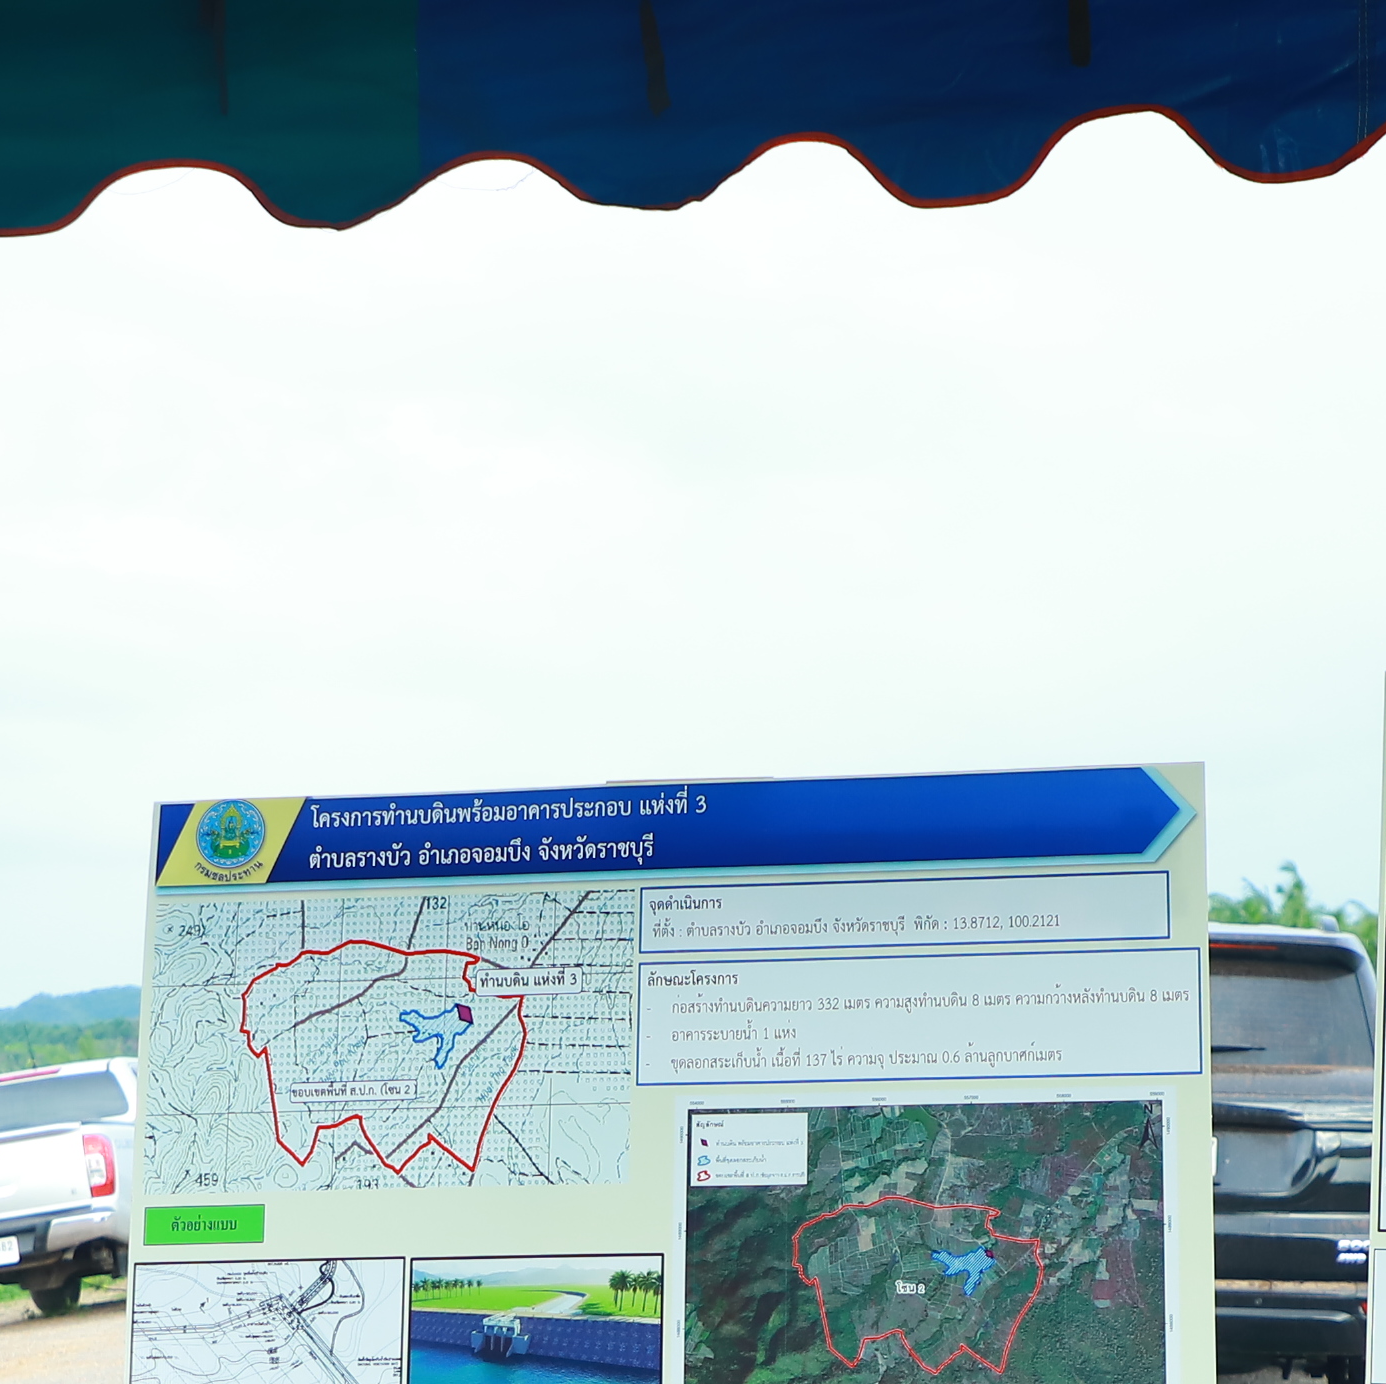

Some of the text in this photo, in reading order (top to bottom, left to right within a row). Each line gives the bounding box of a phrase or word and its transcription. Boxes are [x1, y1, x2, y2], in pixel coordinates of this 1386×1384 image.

[310, 785, 707, 828] โครงการทำนบดินพร้อมอาคารประกอบ แห่งที่ 3
[309, 832, 654, 869] ตำบลรางบัว อำเภอจอมบึง จังหวัดราชบุรี
[193, 860, 264, 883] กรมชลประทาน
[426, 897, 447, 910] 132
[649, 894, 722, 916] จุดดำเนินการ
[652, 914, 1060, 938] ที่ตั้ง ตำบลรางบัว อำเภอจอมบึง จังหวัดราชบุรี พิกัด 13.8712, 100.2121
[479, 971, 565, 988] ทำนบดิน แห่งที่
[647, 969, 738, 987] ลักษณะโครงการ
[817, 990, 1189, 1014] 332 เมตร ความสูงทำนบดิน เมตร เมตร
[671, 1019, 797, 1042] อาคารระบายน้ำ แห่ง
[771, 1045, 961, 1070] เนื้อที่ 137 ไร่ ความจุ ประมาณ 0.6
[195, 1173, 219, 1188] 459
[171, 1214, 238, 1232] ตัวอย่างแบบ
